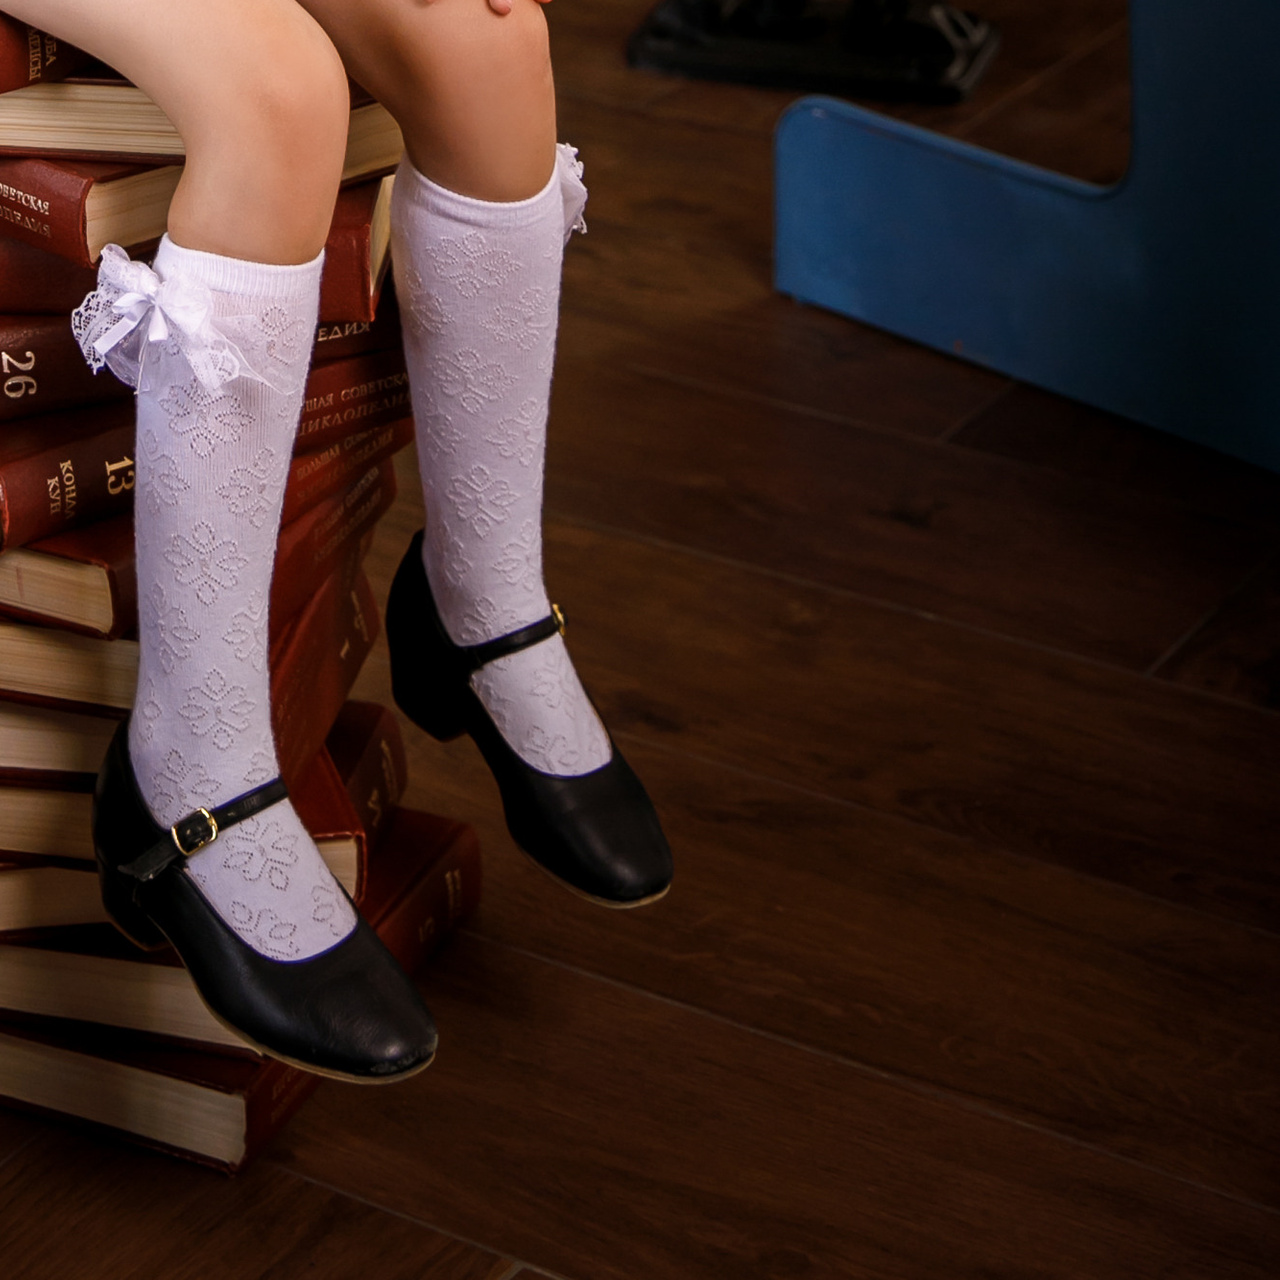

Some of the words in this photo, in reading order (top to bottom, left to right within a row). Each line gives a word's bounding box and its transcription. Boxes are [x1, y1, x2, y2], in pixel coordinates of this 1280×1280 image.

[1, 350, 38, 399] 26
[46, 476, 62, 516] КУН
[105, 455, 136, 496] 13
